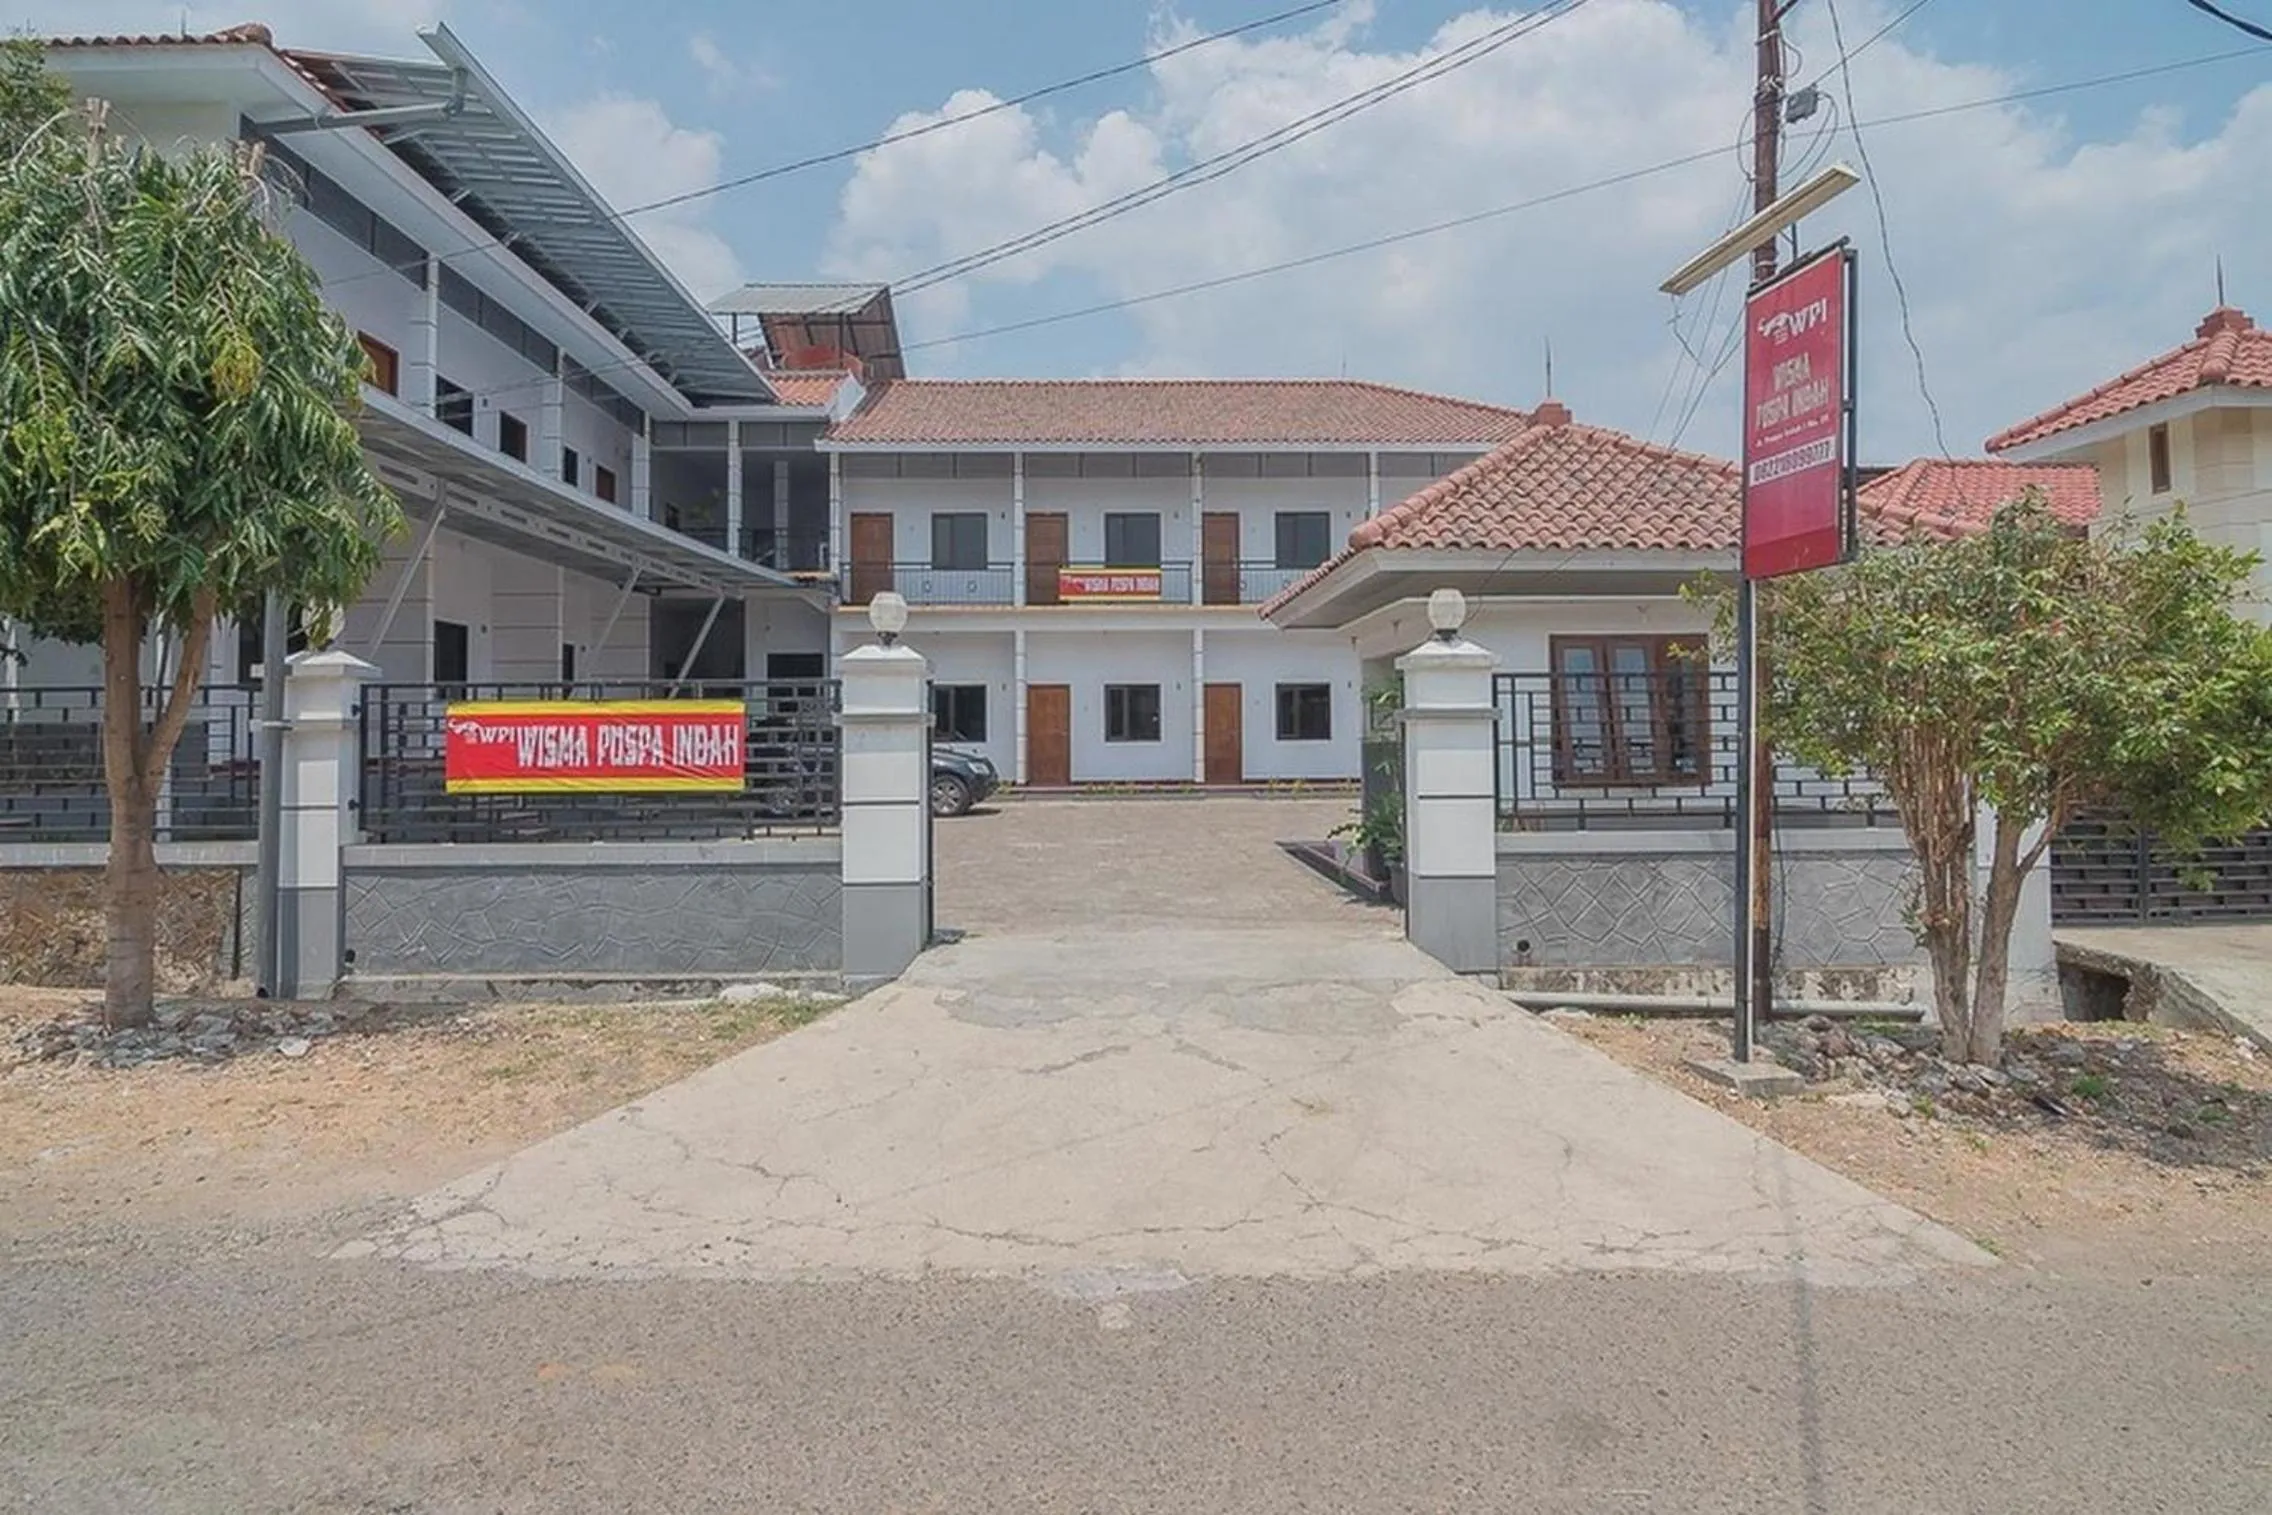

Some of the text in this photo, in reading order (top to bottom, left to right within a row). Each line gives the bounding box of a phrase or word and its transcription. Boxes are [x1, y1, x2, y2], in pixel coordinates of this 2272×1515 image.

[1789, 298, 1827, 336] WPI
[479, 726, 515, 744] WPI
[517, 724, 740, 768] WISMA PUSPA INDAH
